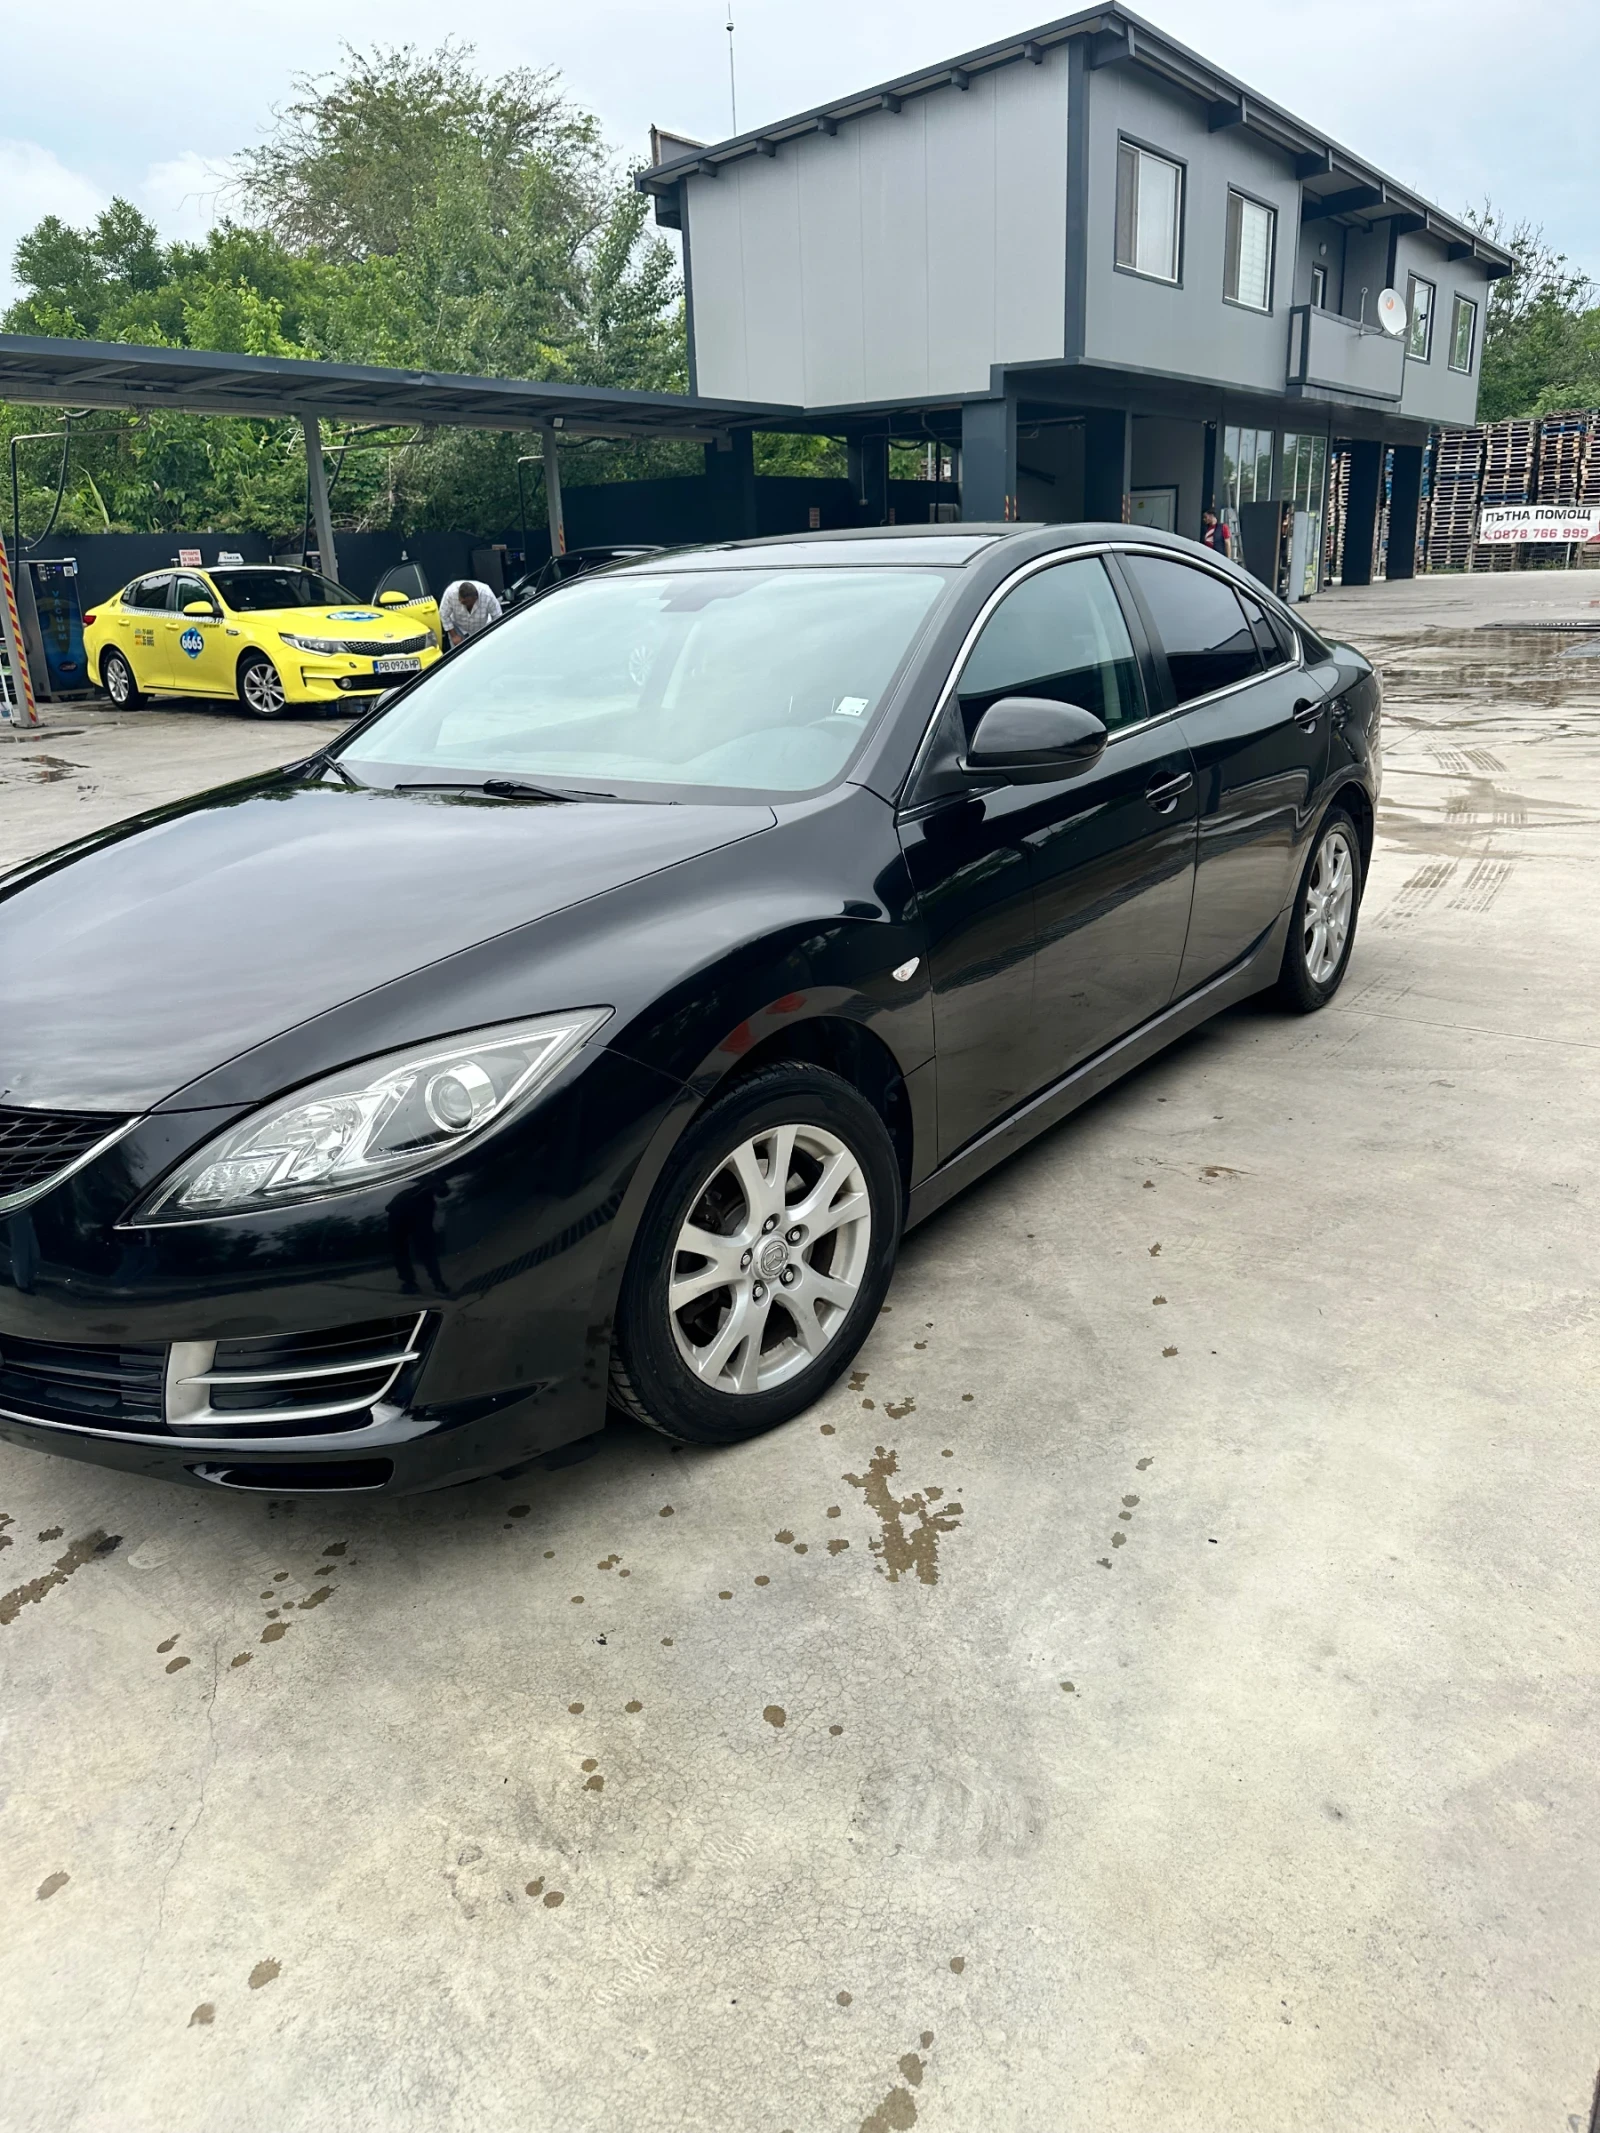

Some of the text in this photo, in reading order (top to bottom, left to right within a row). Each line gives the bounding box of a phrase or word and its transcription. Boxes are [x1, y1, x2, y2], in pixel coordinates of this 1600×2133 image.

[1485, 509, 1592, 522] ПЪТНА ПОМОЩ
[1493, 528, 1589, 540] 0878 766 999
[52, 590, 68, 640] VACUUM
[181, 635, 203, 650] 6665
[379, 659, 419, 671] PB 0926 HP
